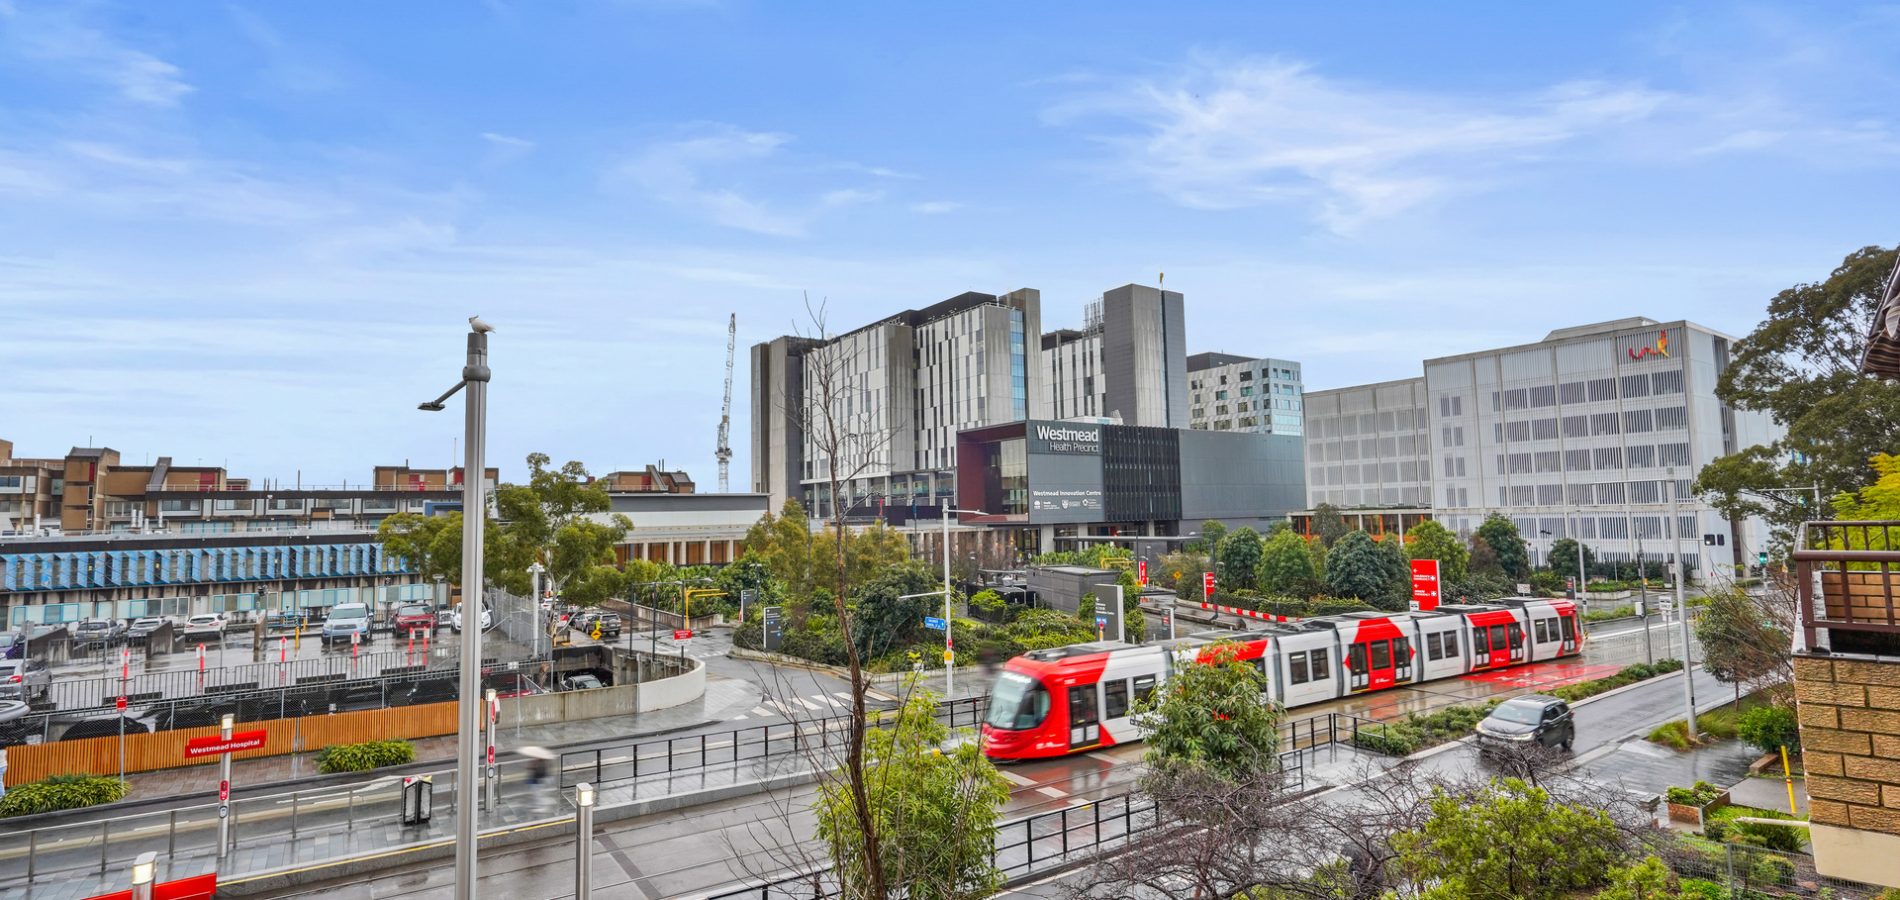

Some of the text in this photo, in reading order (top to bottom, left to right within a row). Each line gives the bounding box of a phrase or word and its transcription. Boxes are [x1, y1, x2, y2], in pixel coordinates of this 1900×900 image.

[1036, 425, 1099, 442] Westmead
[1050, 442, 1099, 453] Health Precinct
[190, 739, 260, 754] Westmead Hospital
